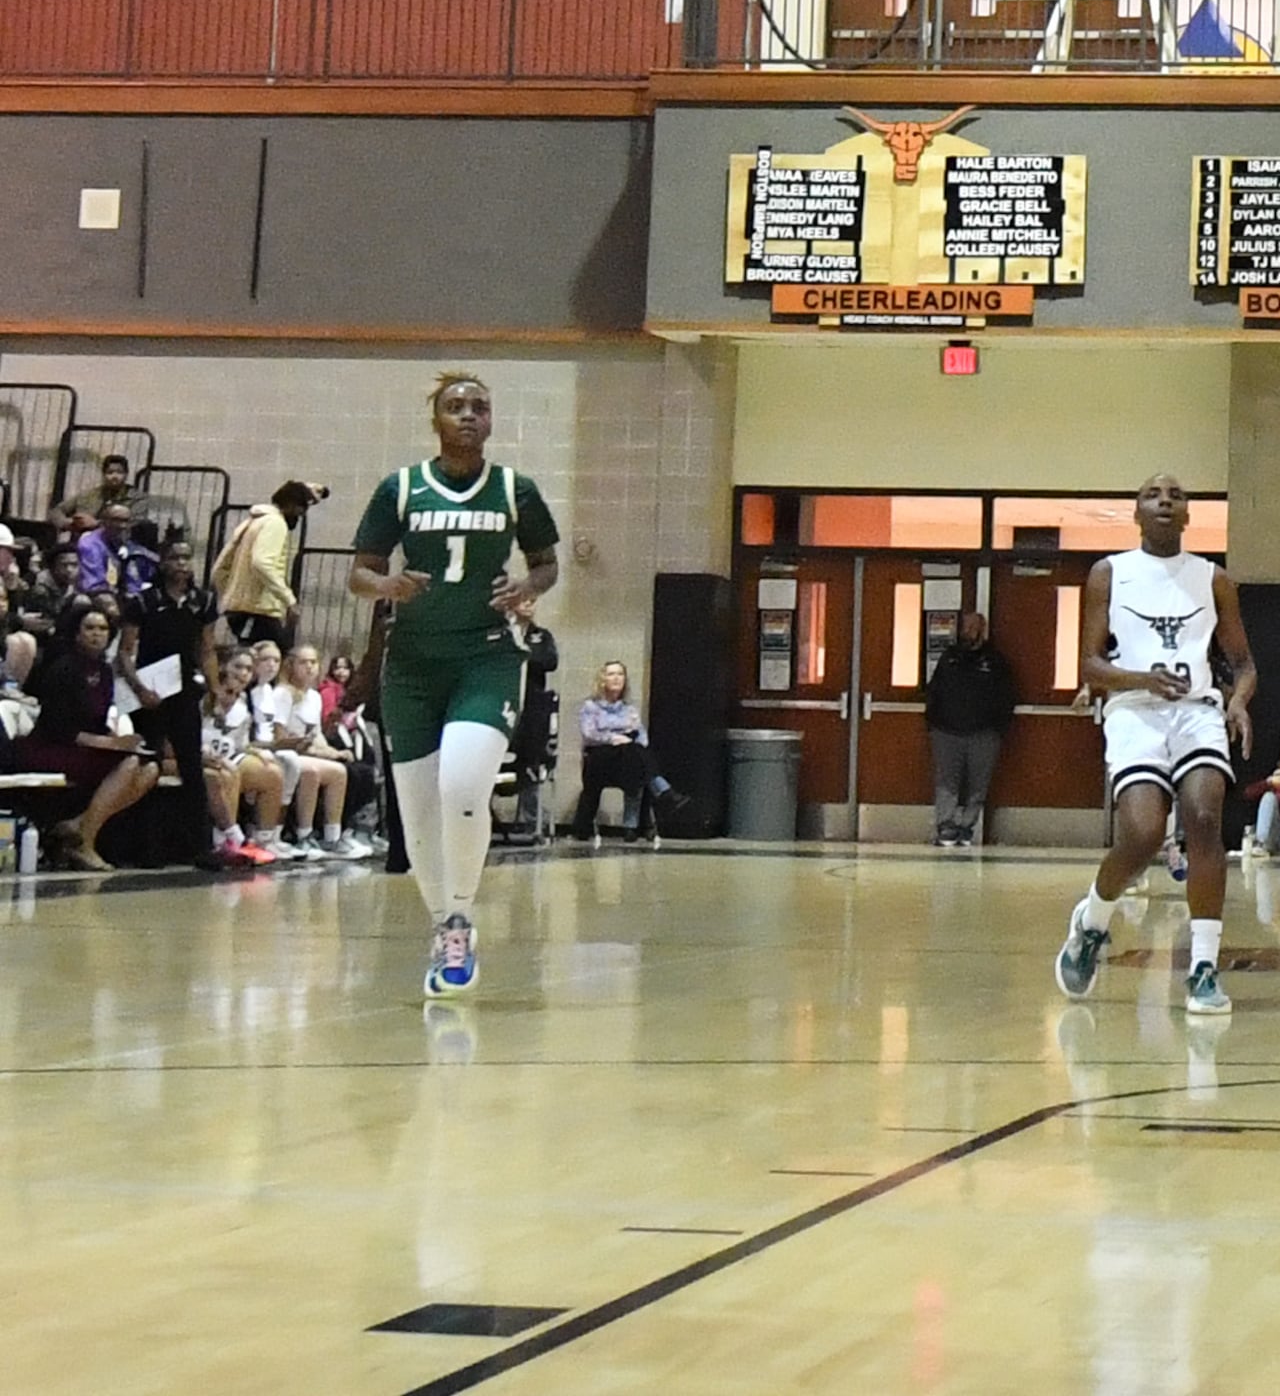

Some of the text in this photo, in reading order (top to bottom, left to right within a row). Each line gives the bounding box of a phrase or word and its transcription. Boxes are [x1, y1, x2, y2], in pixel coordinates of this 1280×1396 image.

[997, 157, 1052, 169] BARTON
[755, 150, 771, 201] BOSTON
[947, 172, 1058, 183] MAURA BENEDETTO
[810, 185, 859, 197] MARTIN
[959, 186, 1045, 198] BESS FEDER
[960, 200, 1051, 212] GRACIE BELL
[818, 213, 854, 225] LANG
[962, 215, 1043, 226] HAILEY BAL
[1233, 210, 1274, 220] DYLAN
[767, 226, 839, 239] MYA KEELS
[946, 229, 1060, 241] ANNIE MITCHELL
[946, 243, 1060, 255] COLLEEN CAUSEY
[1200, 240, 1215, 251] 10
[1231, 241, 1275, 252] JULIUS
[807, 257, 856, 268] GLOVER
[1200, 256, 1215, 267] 12
[1252, 256, 1267, 267] TJ
[746, 268, 858, 282] BROOKE CAUSEY
[1231, 272, 1267, 283] JOSH
[803, 289, 1001, 310] CHEERLEADING
[409, 510, 507, 532] PANTHERS
[444, 536, 467, 582] 1
